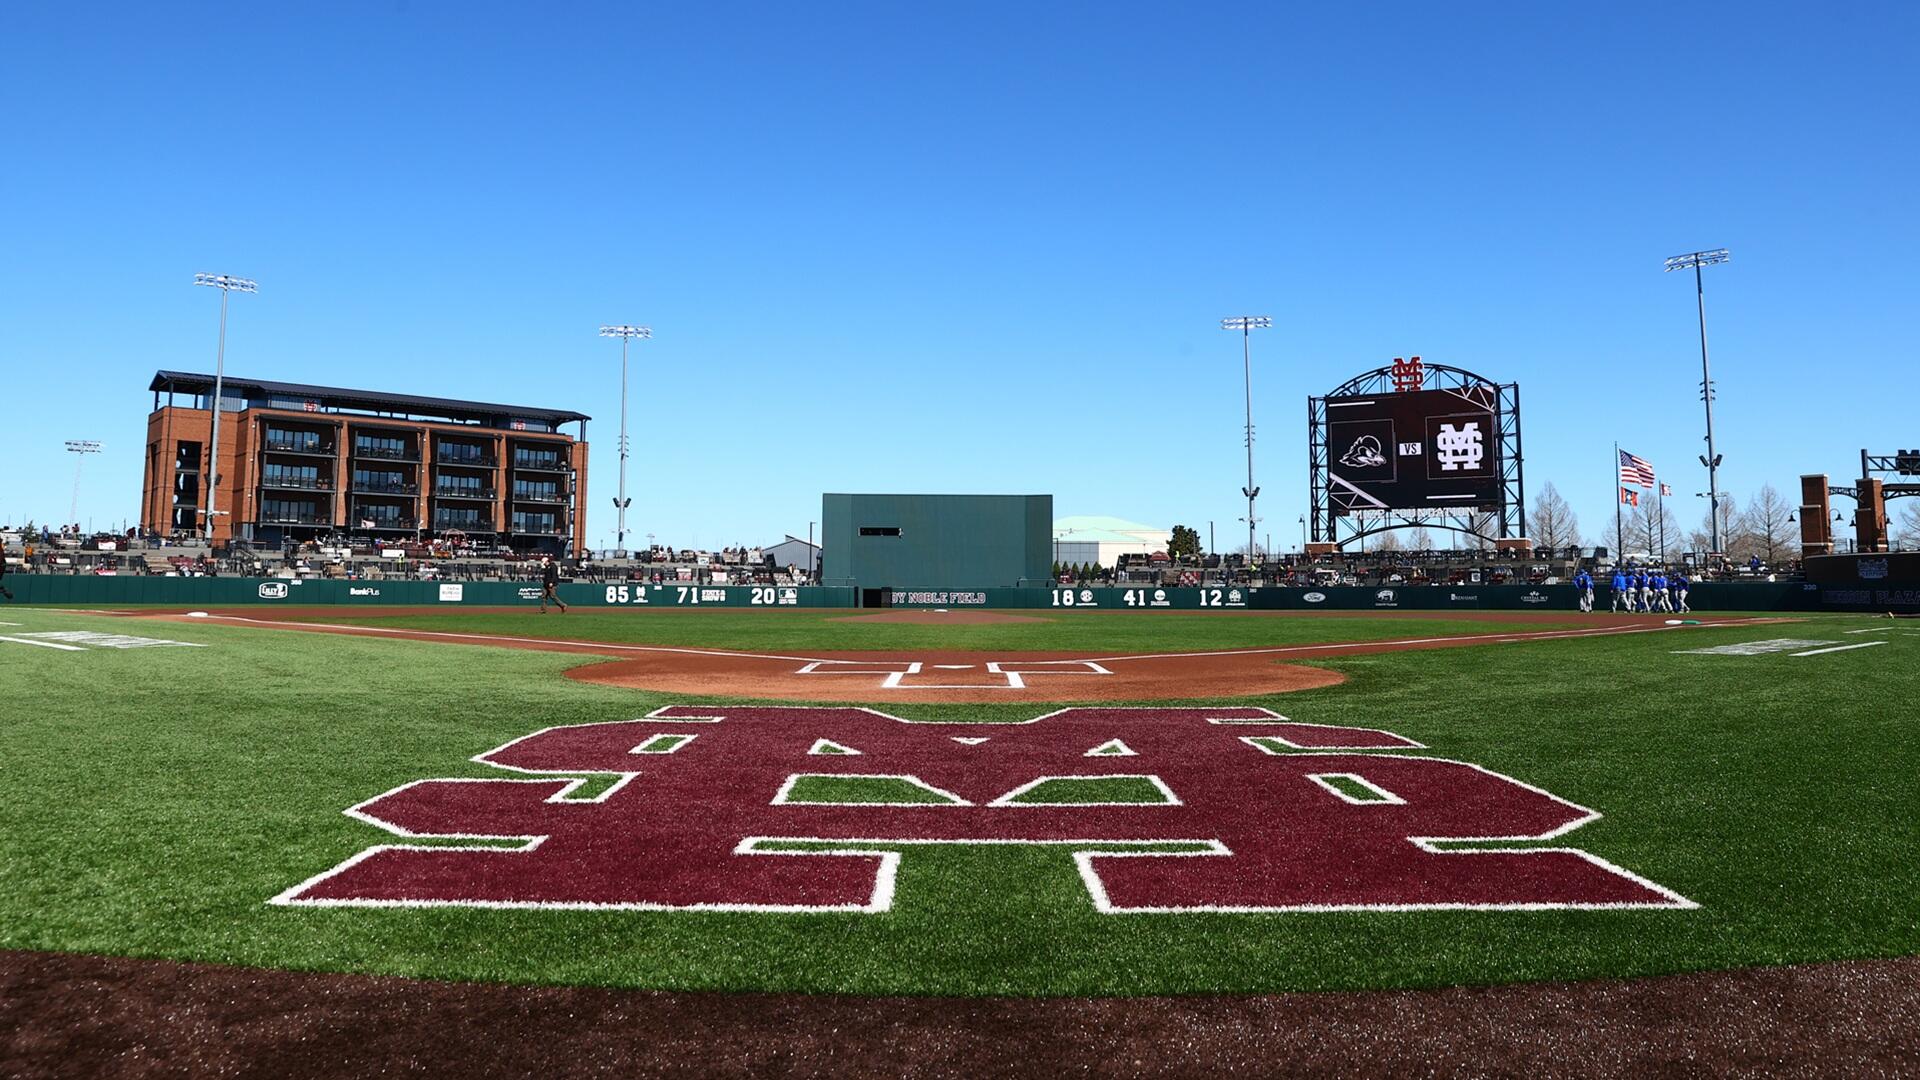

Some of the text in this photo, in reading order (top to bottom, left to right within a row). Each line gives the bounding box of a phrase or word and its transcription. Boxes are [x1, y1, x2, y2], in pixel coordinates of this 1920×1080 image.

[1404, 443, 1418, 455] VS
[1391, 507, 1476, 518] FOUNDATION
[350, 587, 380, 596] BankPlus
[605, 585, 629, 603] 85
[677, 587, 698, 604] 71
[751, 588, 775, 604] 20
[908, 592, 948, 604] NOBLE
[949, 592, 986, 604] FIELD
[1052, 589, 1074, 606] 18
[1123, 589, 1146, 606] 41
[1199, 589, 1222, 606] 12
